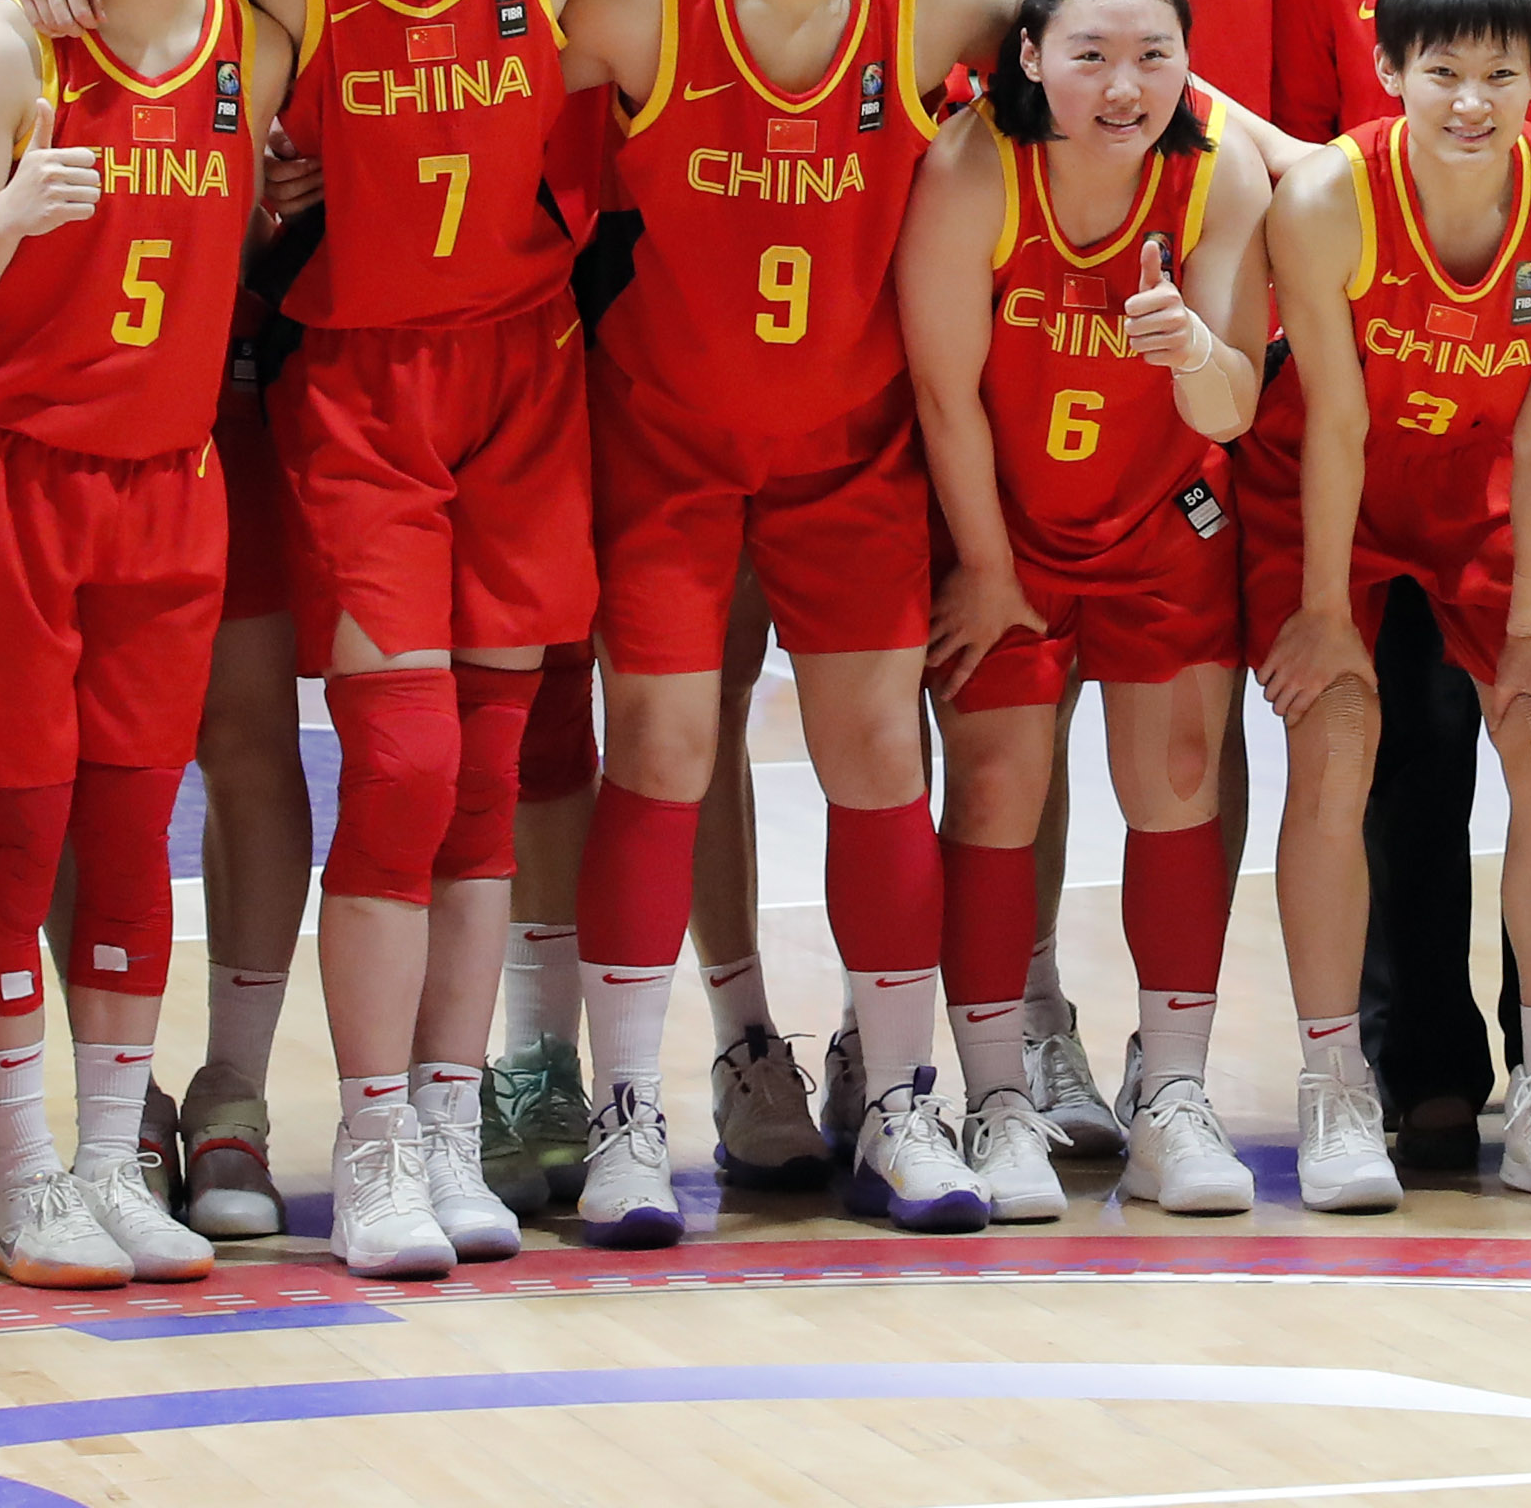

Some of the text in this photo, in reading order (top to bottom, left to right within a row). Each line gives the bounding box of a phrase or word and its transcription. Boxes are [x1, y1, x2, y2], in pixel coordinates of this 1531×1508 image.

[501, 6, 523, 22] FIBA
[217, 102, 237, 117] FIBA
[342, 56, 533, 116] CHINA
[418, 154, 471, 257] 7
[687, 148, 865, 205] CHINA
[111, 239, 172, 347] 5
[755, 246, 812, 344] 9
[1003, 287, 1139, 359] CHIN
[1365, 318, 1531, 377] CHINA
[1046, 389, 1105, 462] 6
[1396, 390, 1459, 435] 3
[1183, 487, 1205, 507] 50
